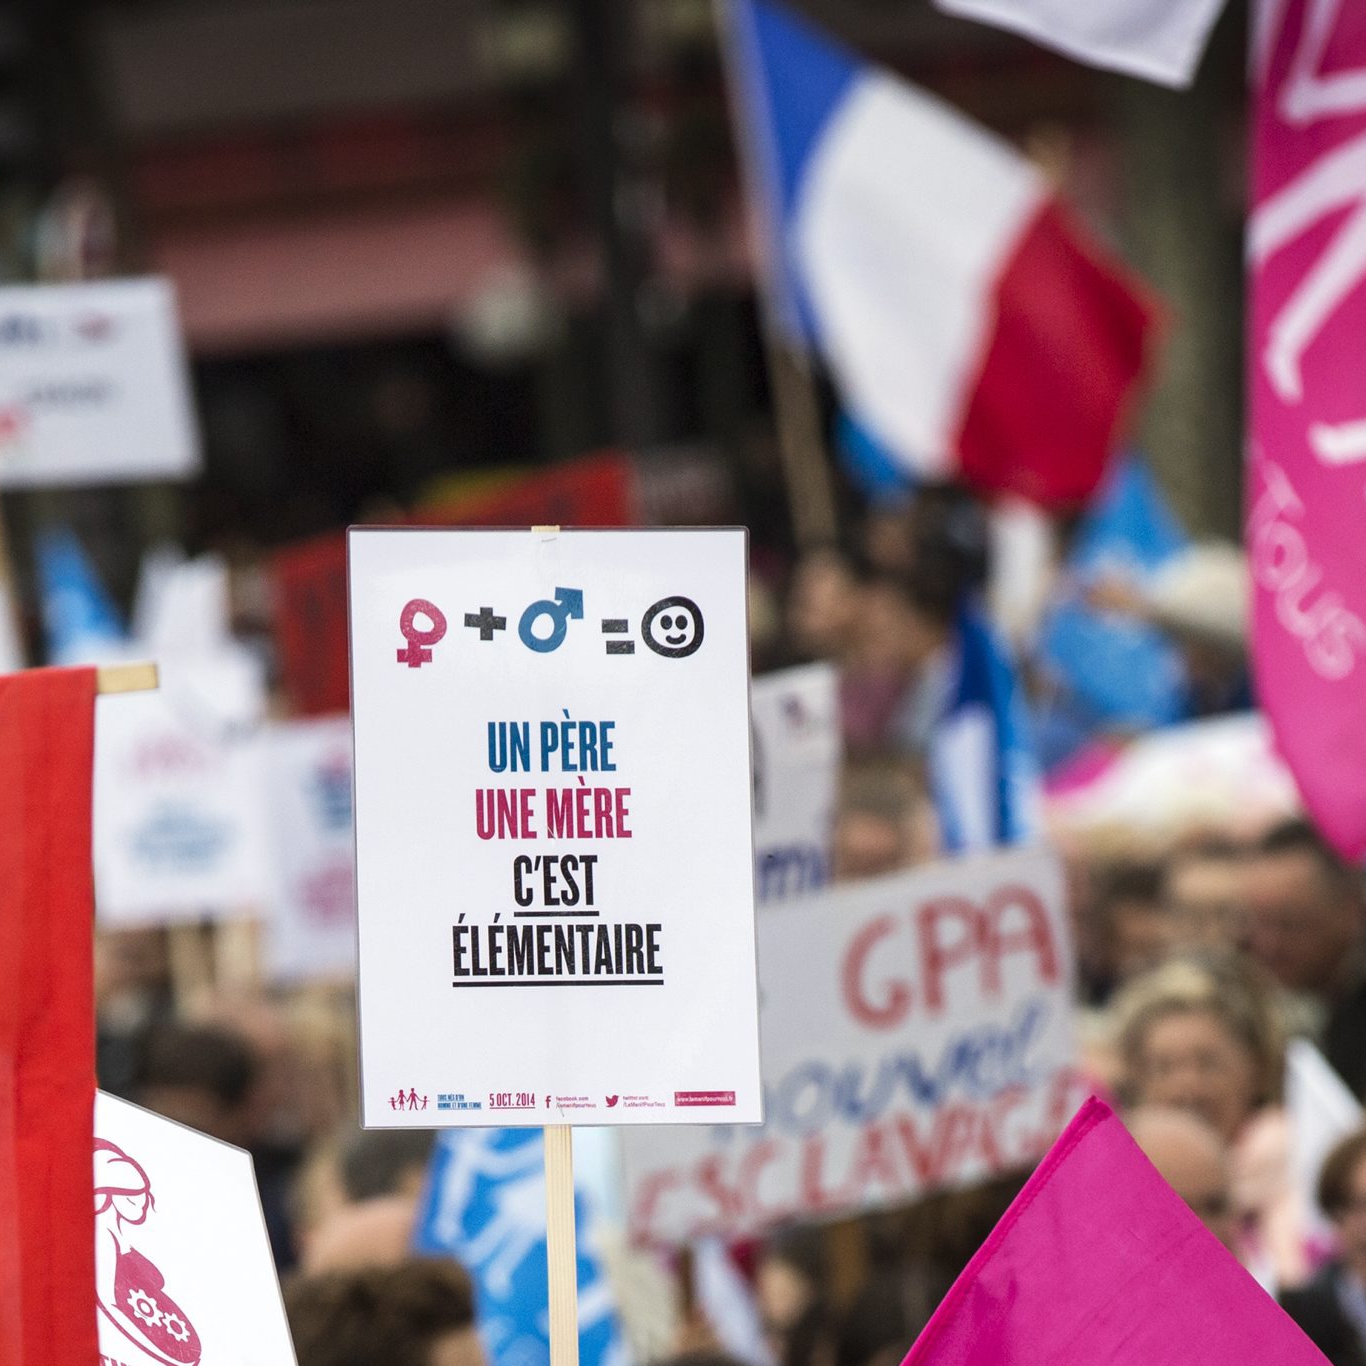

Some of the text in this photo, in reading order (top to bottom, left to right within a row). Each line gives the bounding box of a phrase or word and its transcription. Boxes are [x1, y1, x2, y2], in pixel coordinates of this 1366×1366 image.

[487, 708, 616, 772] UN PÈRE
[475, 775, 632, 840] UNE MÈRE
[513, 854, 598, 907] C'EST
[452, 912, 663, 976] ÉLÉMENTAIRE
[841, 884, 1061, 1032] GPA
[489, 1093, 495, 1106] 5
[516, 1092, 535, 1106] 2014
